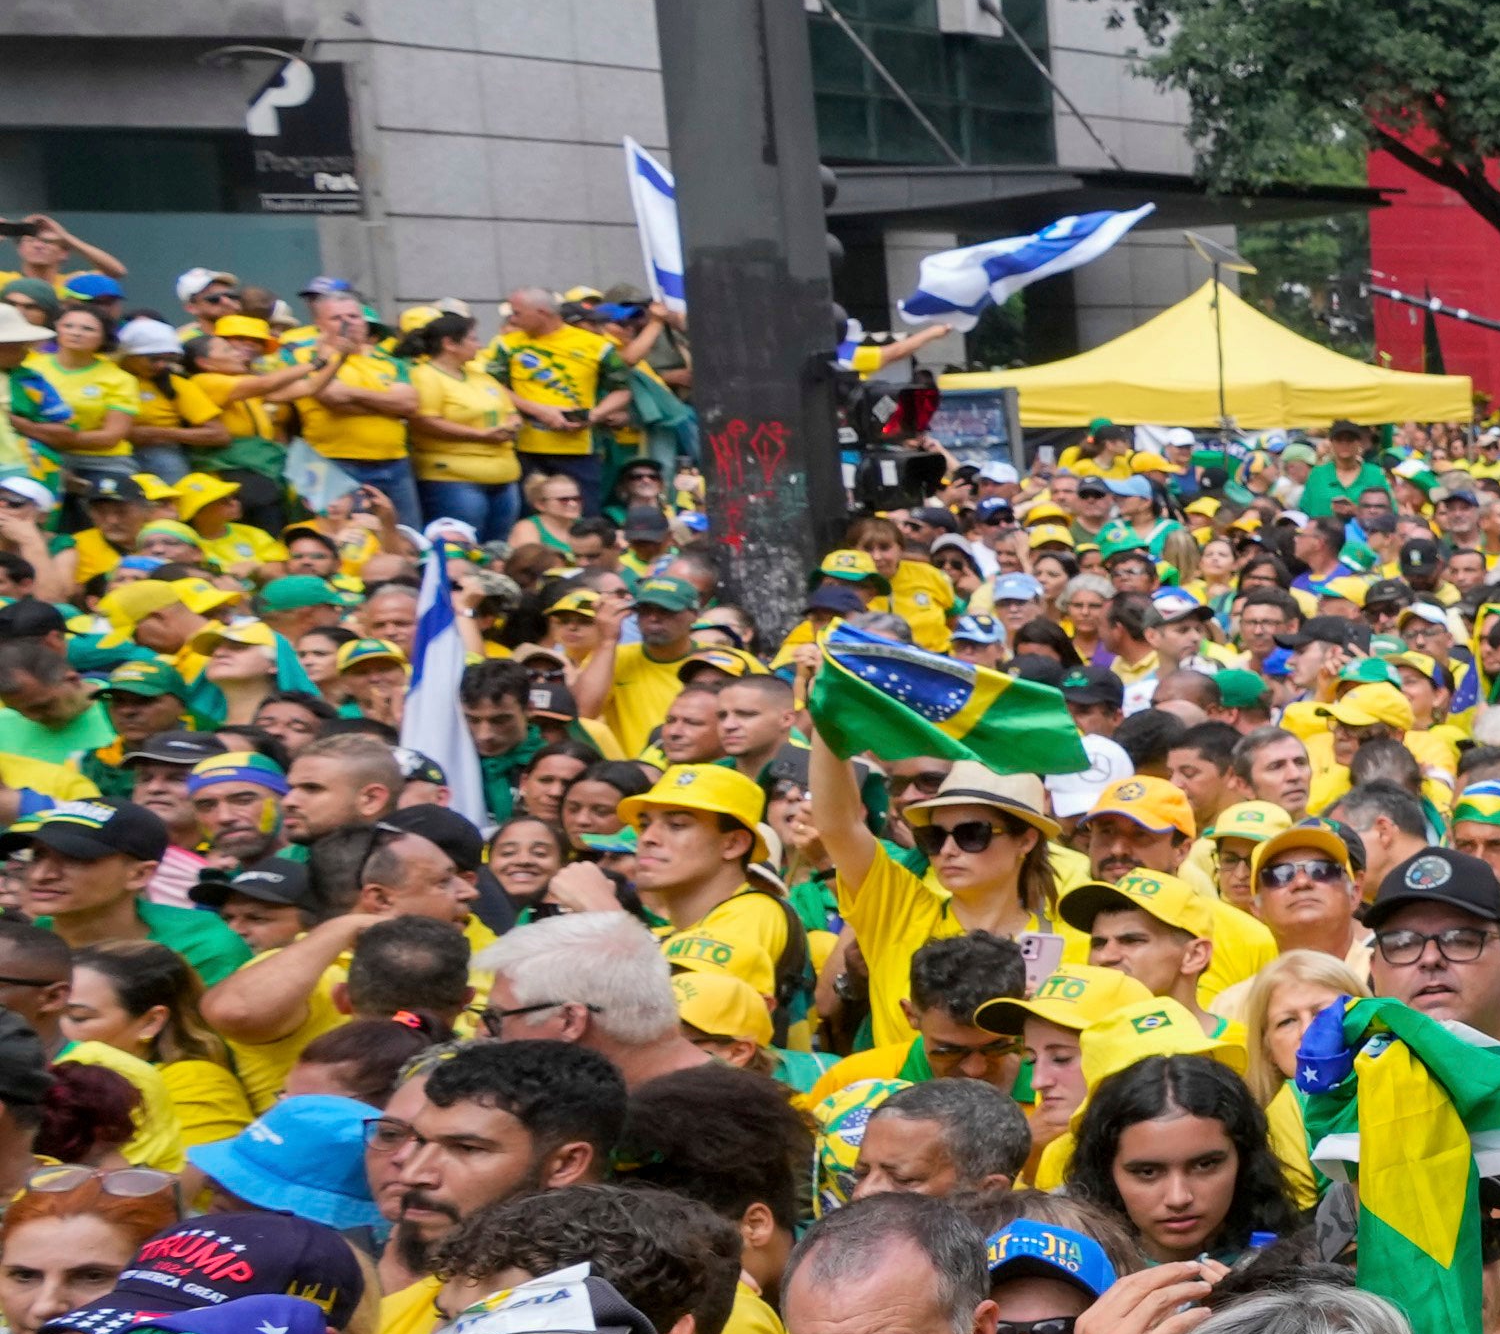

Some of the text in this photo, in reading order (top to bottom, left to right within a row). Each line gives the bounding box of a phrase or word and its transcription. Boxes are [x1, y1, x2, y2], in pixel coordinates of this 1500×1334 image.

[1115, 874, 1160, 896] ITO
[666, 938, 733, 964] MITO
[1034, 977, 1085, 1000] ITO
[138, 1233, 254, 1284] TRUMP
[181, 1281, 230, 1303] GREAT
